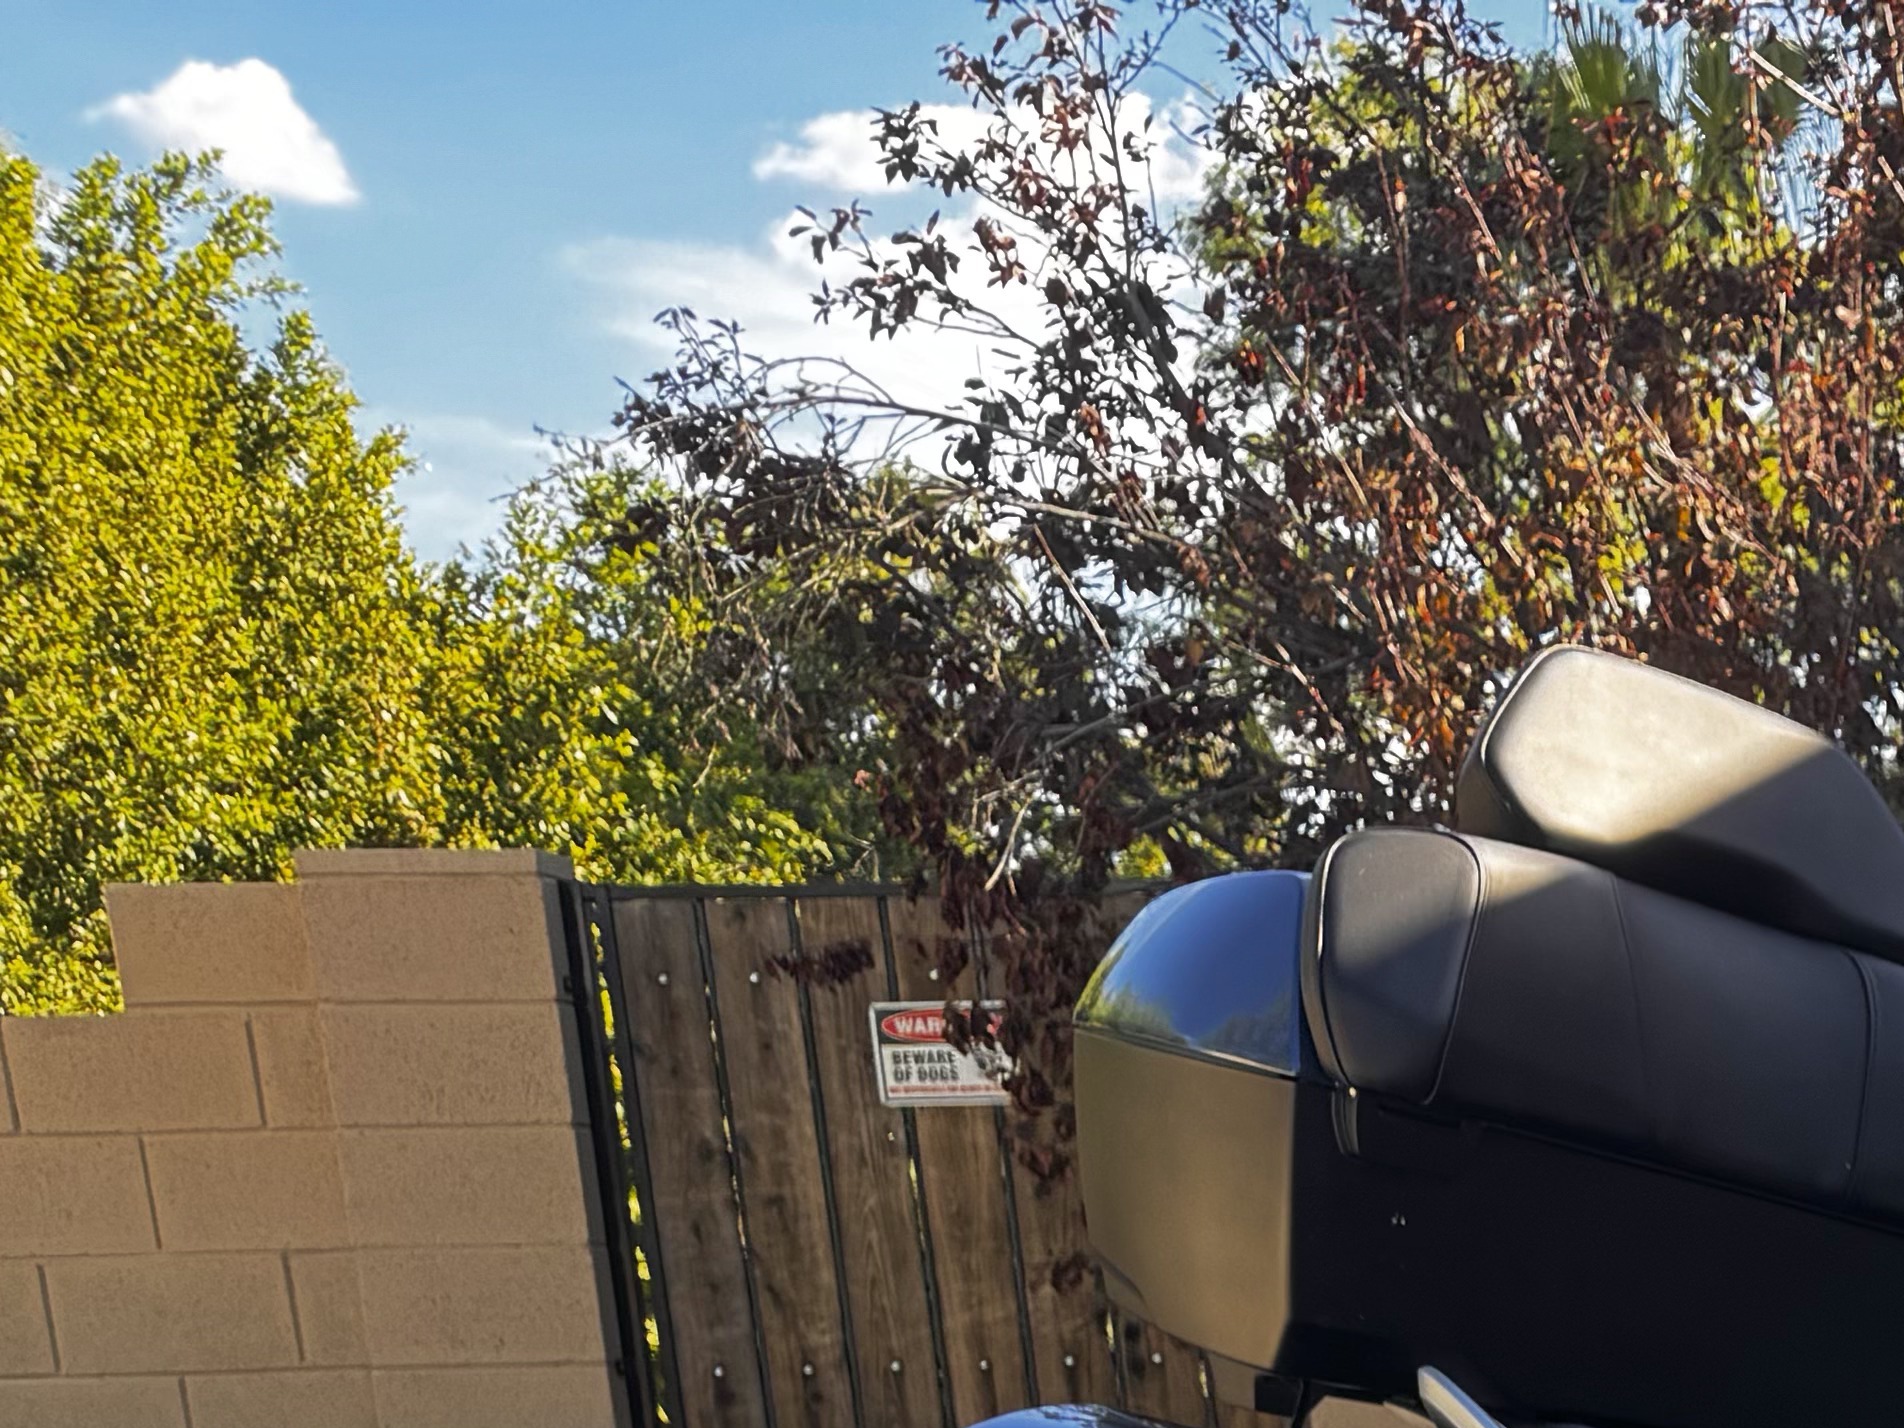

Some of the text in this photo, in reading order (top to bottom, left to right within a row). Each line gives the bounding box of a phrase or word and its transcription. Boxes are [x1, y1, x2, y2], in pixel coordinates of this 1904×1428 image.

[893, 1049, 956, 1065] BEWARE
[894, 1065, 960, 1083] OF DOGS
